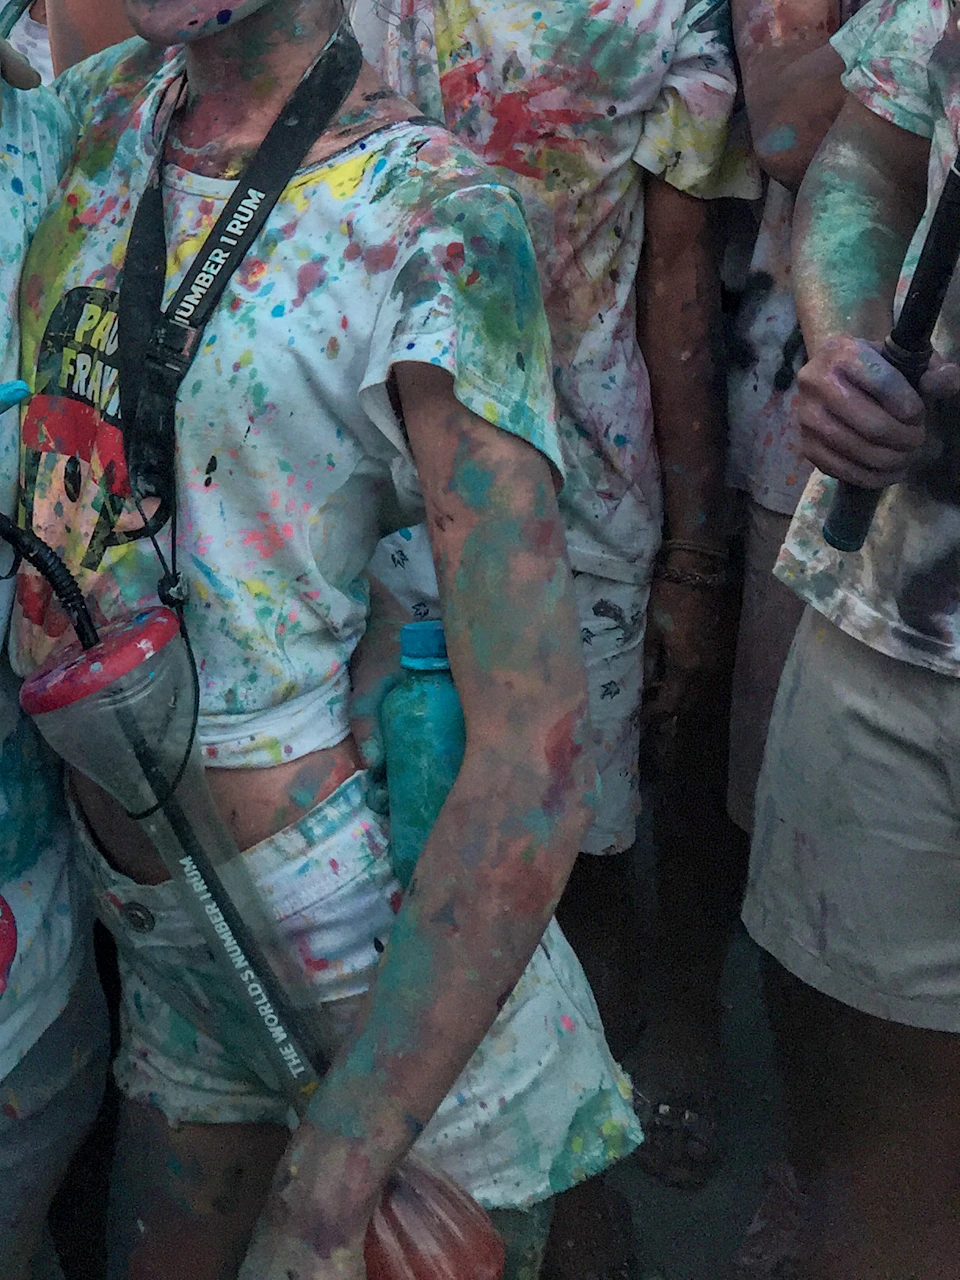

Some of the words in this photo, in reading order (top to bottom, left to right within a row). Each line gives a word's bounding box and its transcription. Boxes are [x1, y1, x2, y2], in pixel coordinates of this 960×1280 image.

[225, 187, 267, 238] RUM
[219, 235, 238, 246] 1
[179, 854, 208, 893] RUM
[199, 892, 212, 902] 1
[204, 901, 250, 970] NUMBER
[279, 1042, 306, 1079] THE
